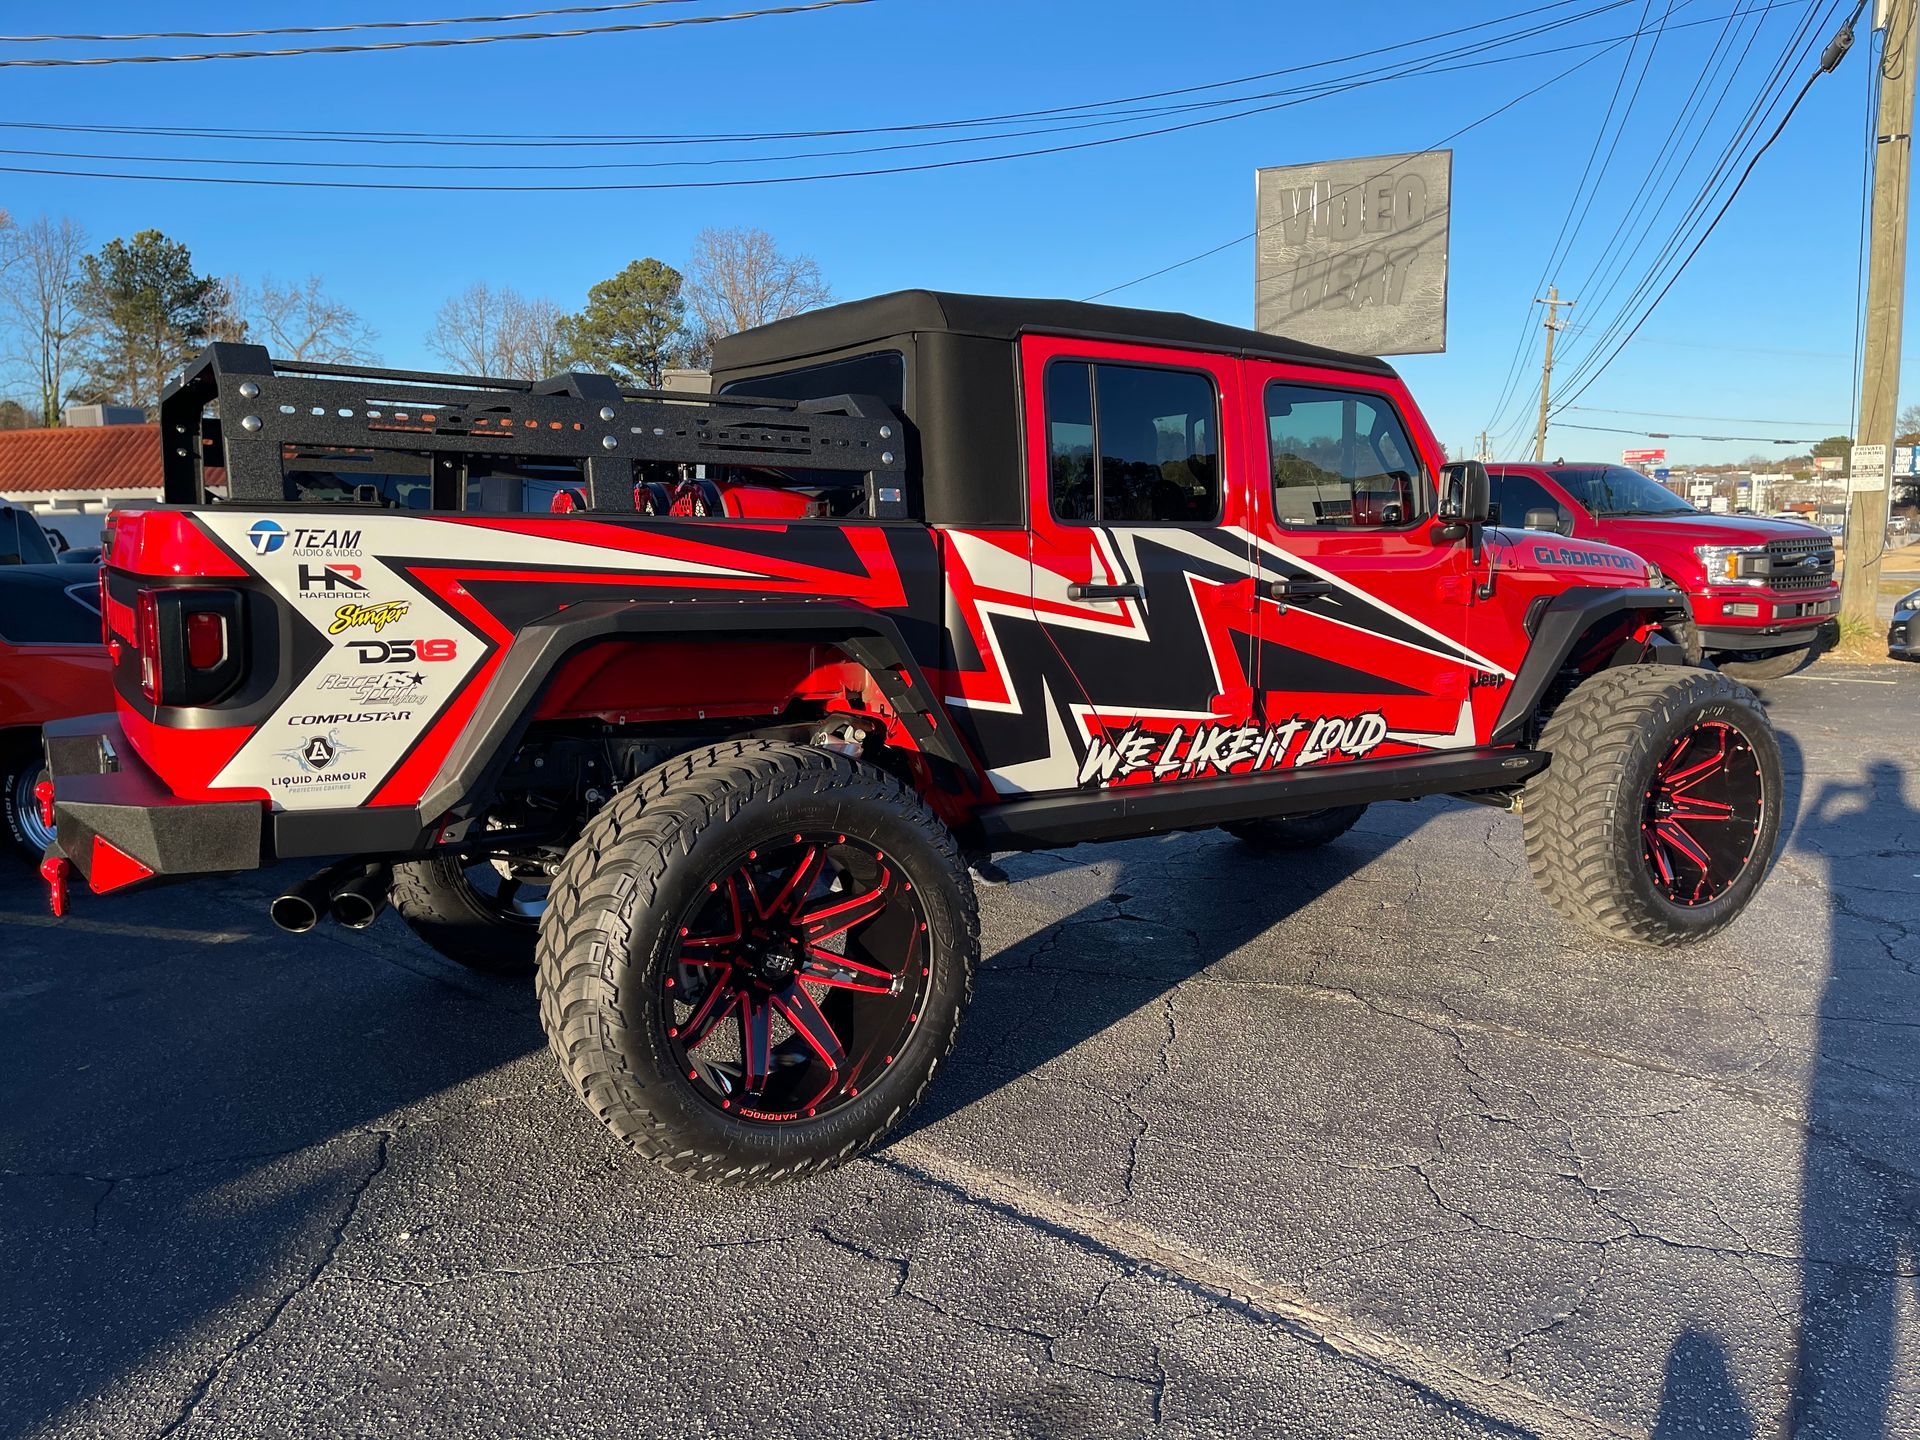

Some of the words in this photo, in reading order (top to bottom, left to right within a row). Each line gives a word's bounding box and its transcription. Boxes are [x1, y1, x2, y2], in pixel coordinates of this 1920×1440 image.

[1281, 173, 1427, 246] VIDEO
[293, 529, 361, 549] TEAM
[292, 549, 324, 557] AUDIO
[325, 549, 333, 557] &
[335, 549, 363, 557] VIDEO
[1533, 547, 1637, 570] GLADIATOR
[298, 564, 369, 590] HR
[328, 600, 409, 635] Stinger
[344, 639, 457, 664] DS18
[317, 673, 379, 690] Race
[1471, 669, 1505, 689] Jeep
[354, 683, 418, 705] Sport
[288, 711, 412, 726] COMPUSTAR
[1079, 727, 1157, 788] WE
[1154, 725, 1259, 778] LIKE
[1253, 718, 1307, 770] IT
[1295, 713, 1387, 767] LOUD
[5, 774, 15, 793] T/A
[271, 775, 312, 788] LIQUID
[316, 772, 367, 784] ARMOUR
[740, 1107, 798, 1121] HARDROCK
